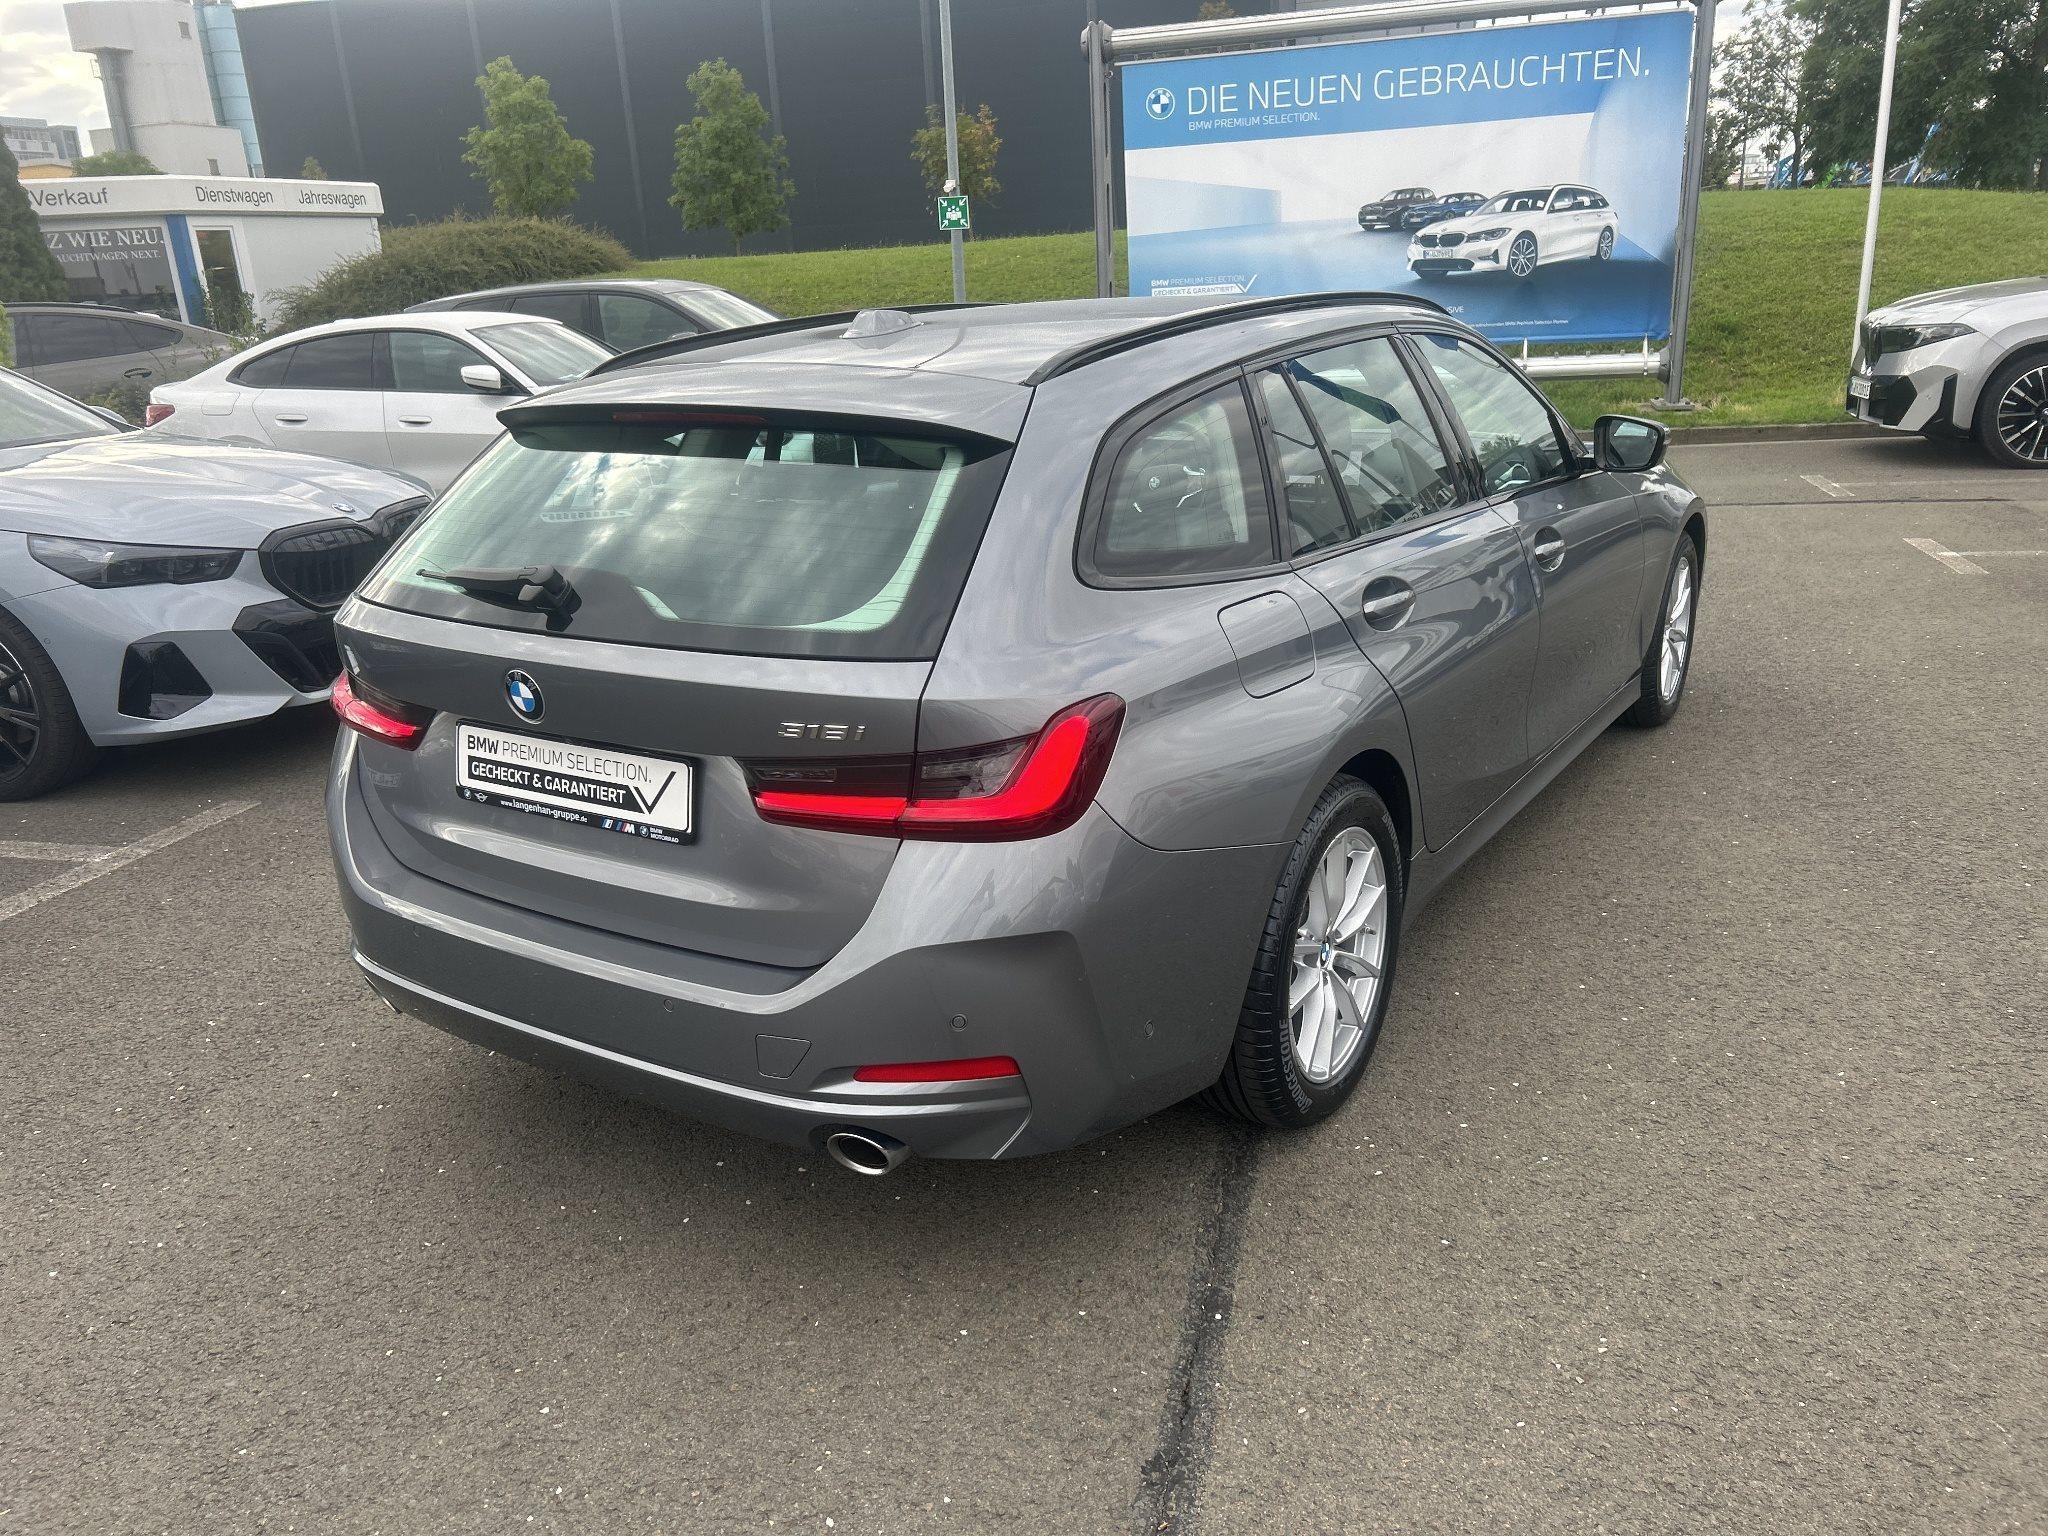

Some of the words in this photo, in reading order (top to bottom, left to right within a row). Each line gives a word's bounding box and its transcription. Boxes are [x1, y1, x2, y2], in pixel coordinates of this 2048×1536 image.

[1188, 84, 1238, 115] DIE
[1249, 73, 1362, 110] NEUEN
[1374, 46, 1650, 100] GEBRAUCHTEN.
[1188, 121, 1212, 131] BMW
[1214, 116, 1260, 128] PREMIUM
[1262, 111, 1320, 125] SELECTION.
[30, 187, 108, 206] Verkauf
[195, 186, 274, 206] Dienstwagen
[298, 189, 367, 208] Jahreswagen
[65, 231, 111, 247] WIE
[115, 229, 164, 245] NEU.
[131, 249, 161, 260] NEXT.
[1447, 306, 1464, 314] SIVE
[467, 734, 499, 755] BMW
[502, 741, 563, 767] PREMIUM
[566, 752, 652, 784] SELECTION.
[471, 761, 531, 785] GECHECKT
[532, 773, 543, 788] &
[544, 776, 626, 804] GARANTIERT
[500, 799, 588, 823] www.langenhan-gruppe.de
[650, 832, 679, 843] MOTORRAD
[1279, 1018, 1313, 1114] BRIDGESTONE
